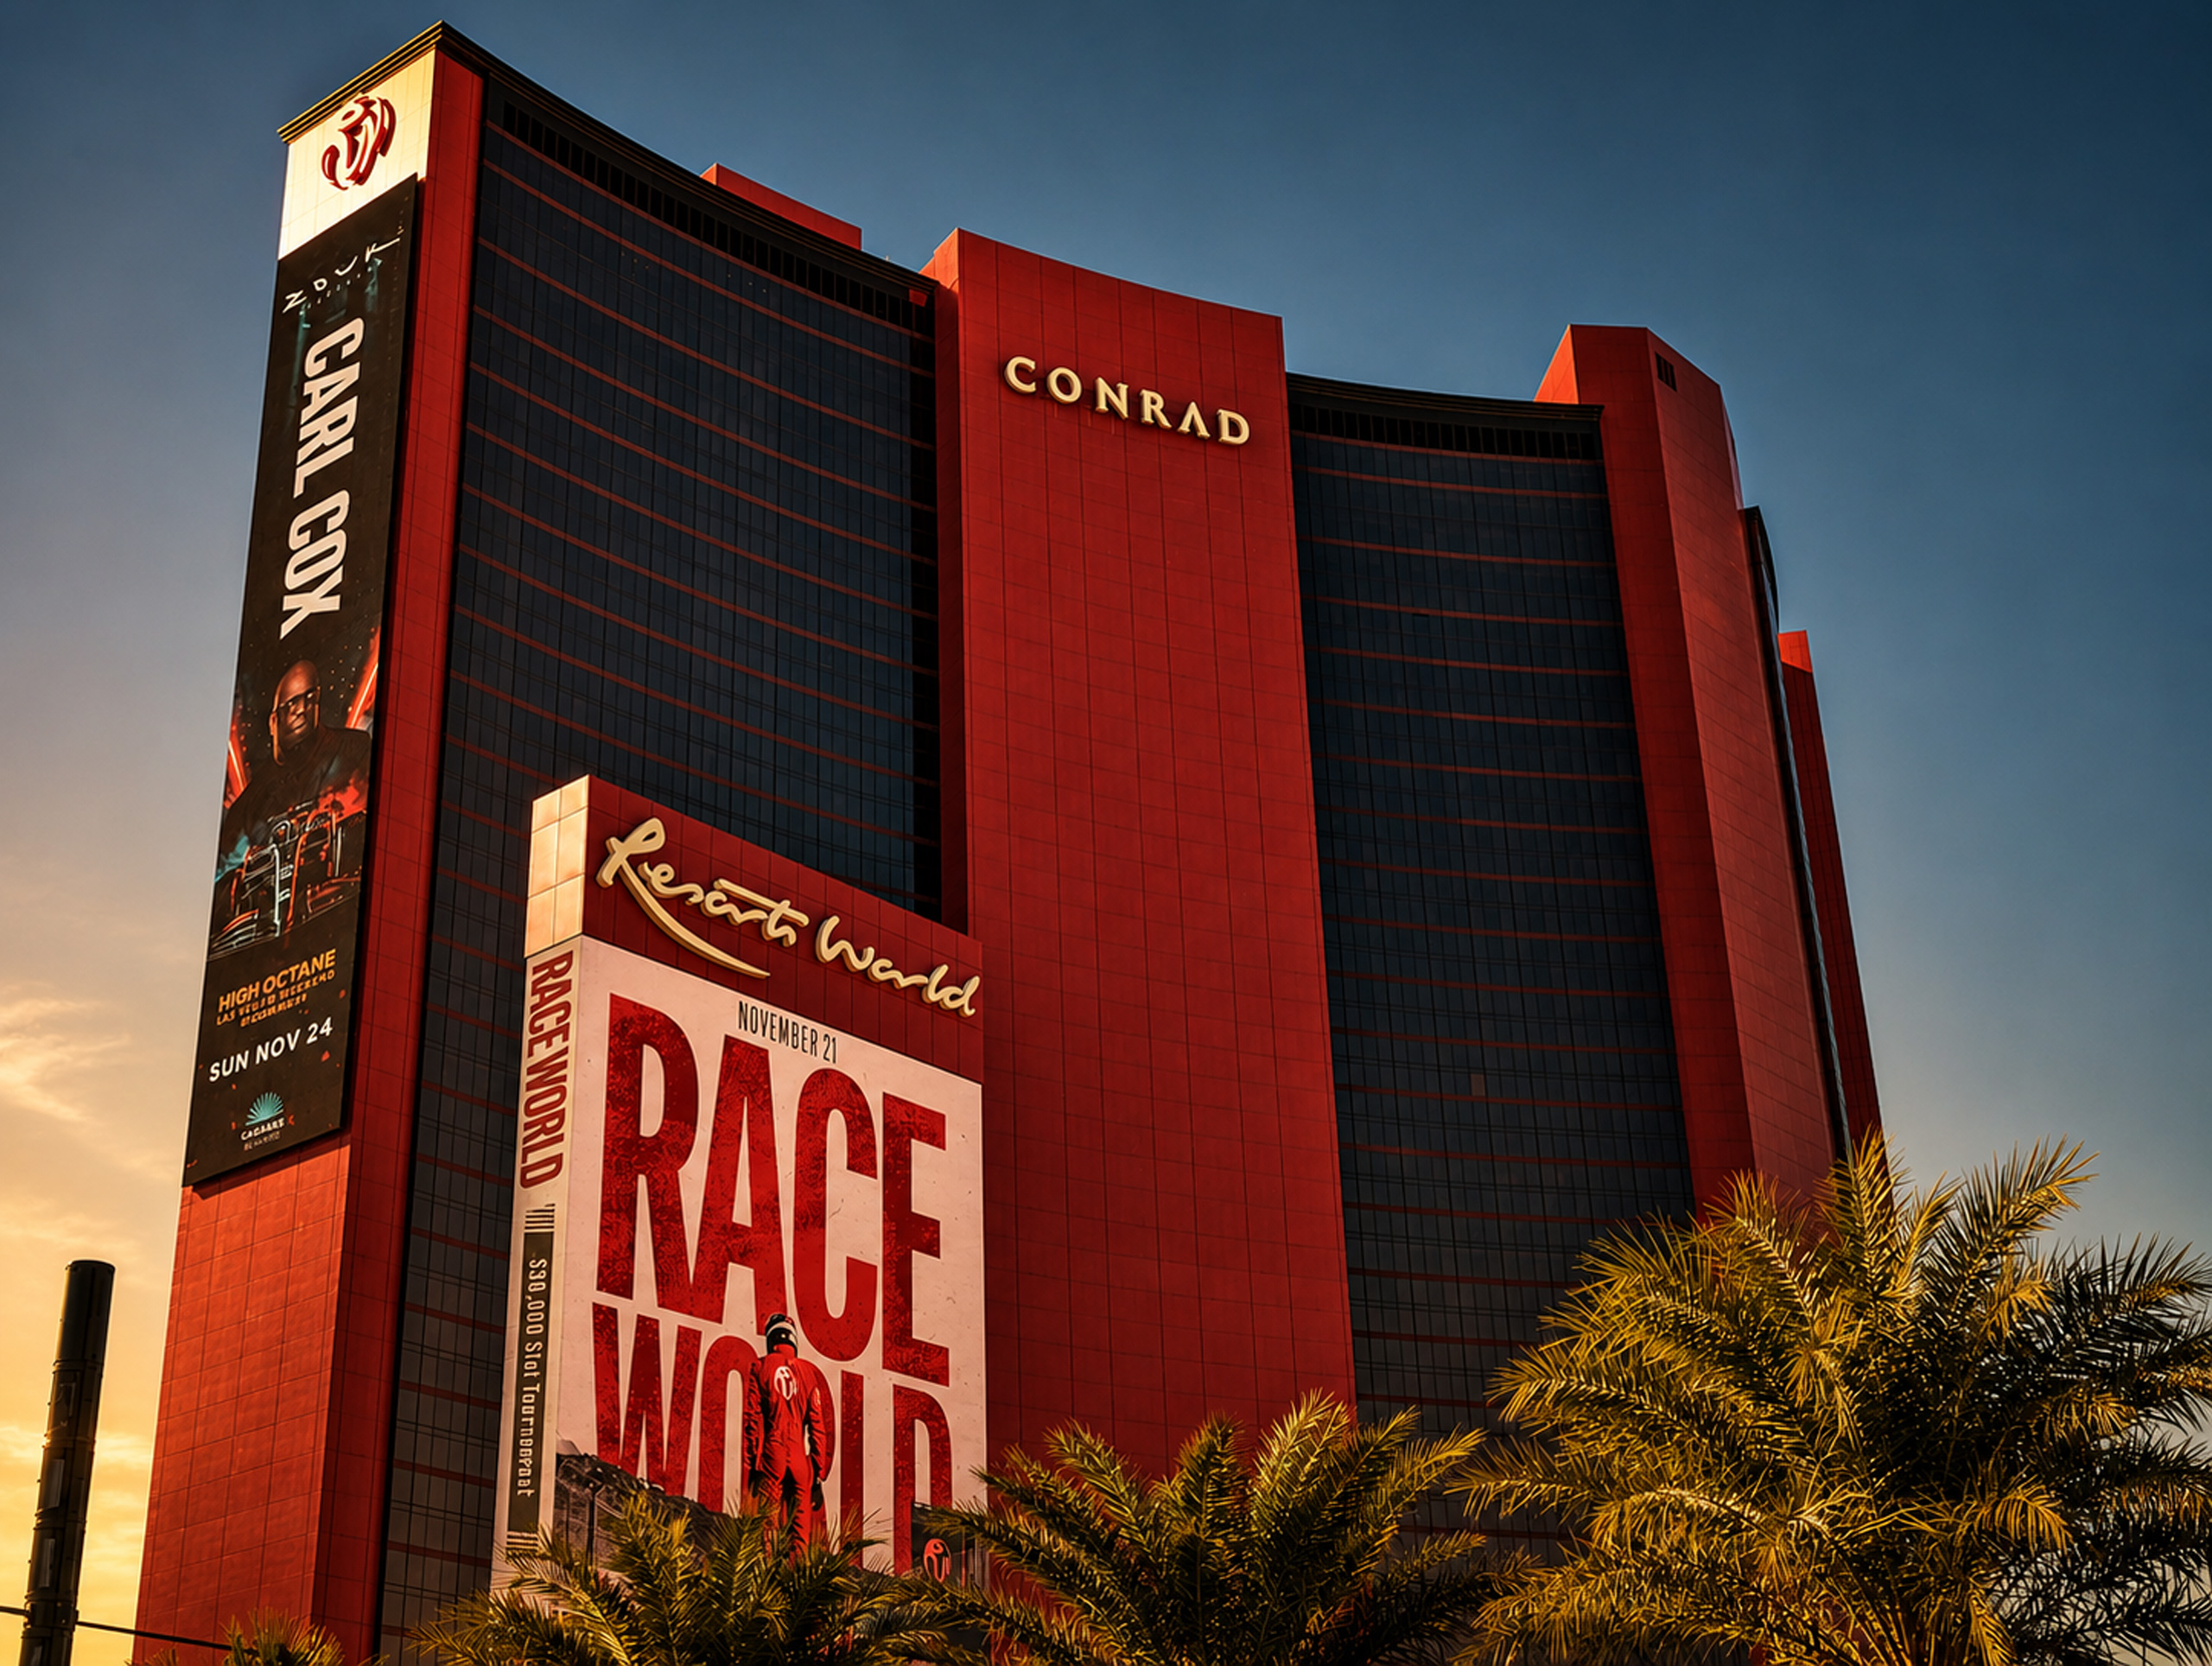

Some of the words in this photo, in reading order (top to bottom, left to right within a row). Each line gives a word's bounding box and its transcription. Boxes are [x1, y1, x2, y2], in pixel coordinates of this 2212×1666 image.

[293, 317, 364, 499] CARL
[1004, 355, 1250, 445] CONRAD
[280, 489, 350, 640] COX
[596, 817, 809, 979] Resorts
[815, 914, 980, 1017] World
[218, 981, 260, 1013] HIGH
[262, 948, 336, 995] OCTANE
[209, 1049, 250, 1082] SUN
[255, 1028, 301, 1065] NOV
[306, 1015, 334, 1045] 24
[739, 1001, 817, 1057] NOVEMBER
[823, 1033, 836, 1065] 21
[595, 993, 950, 1387] RACE
[523, 1341, 543, 1378] Slot
